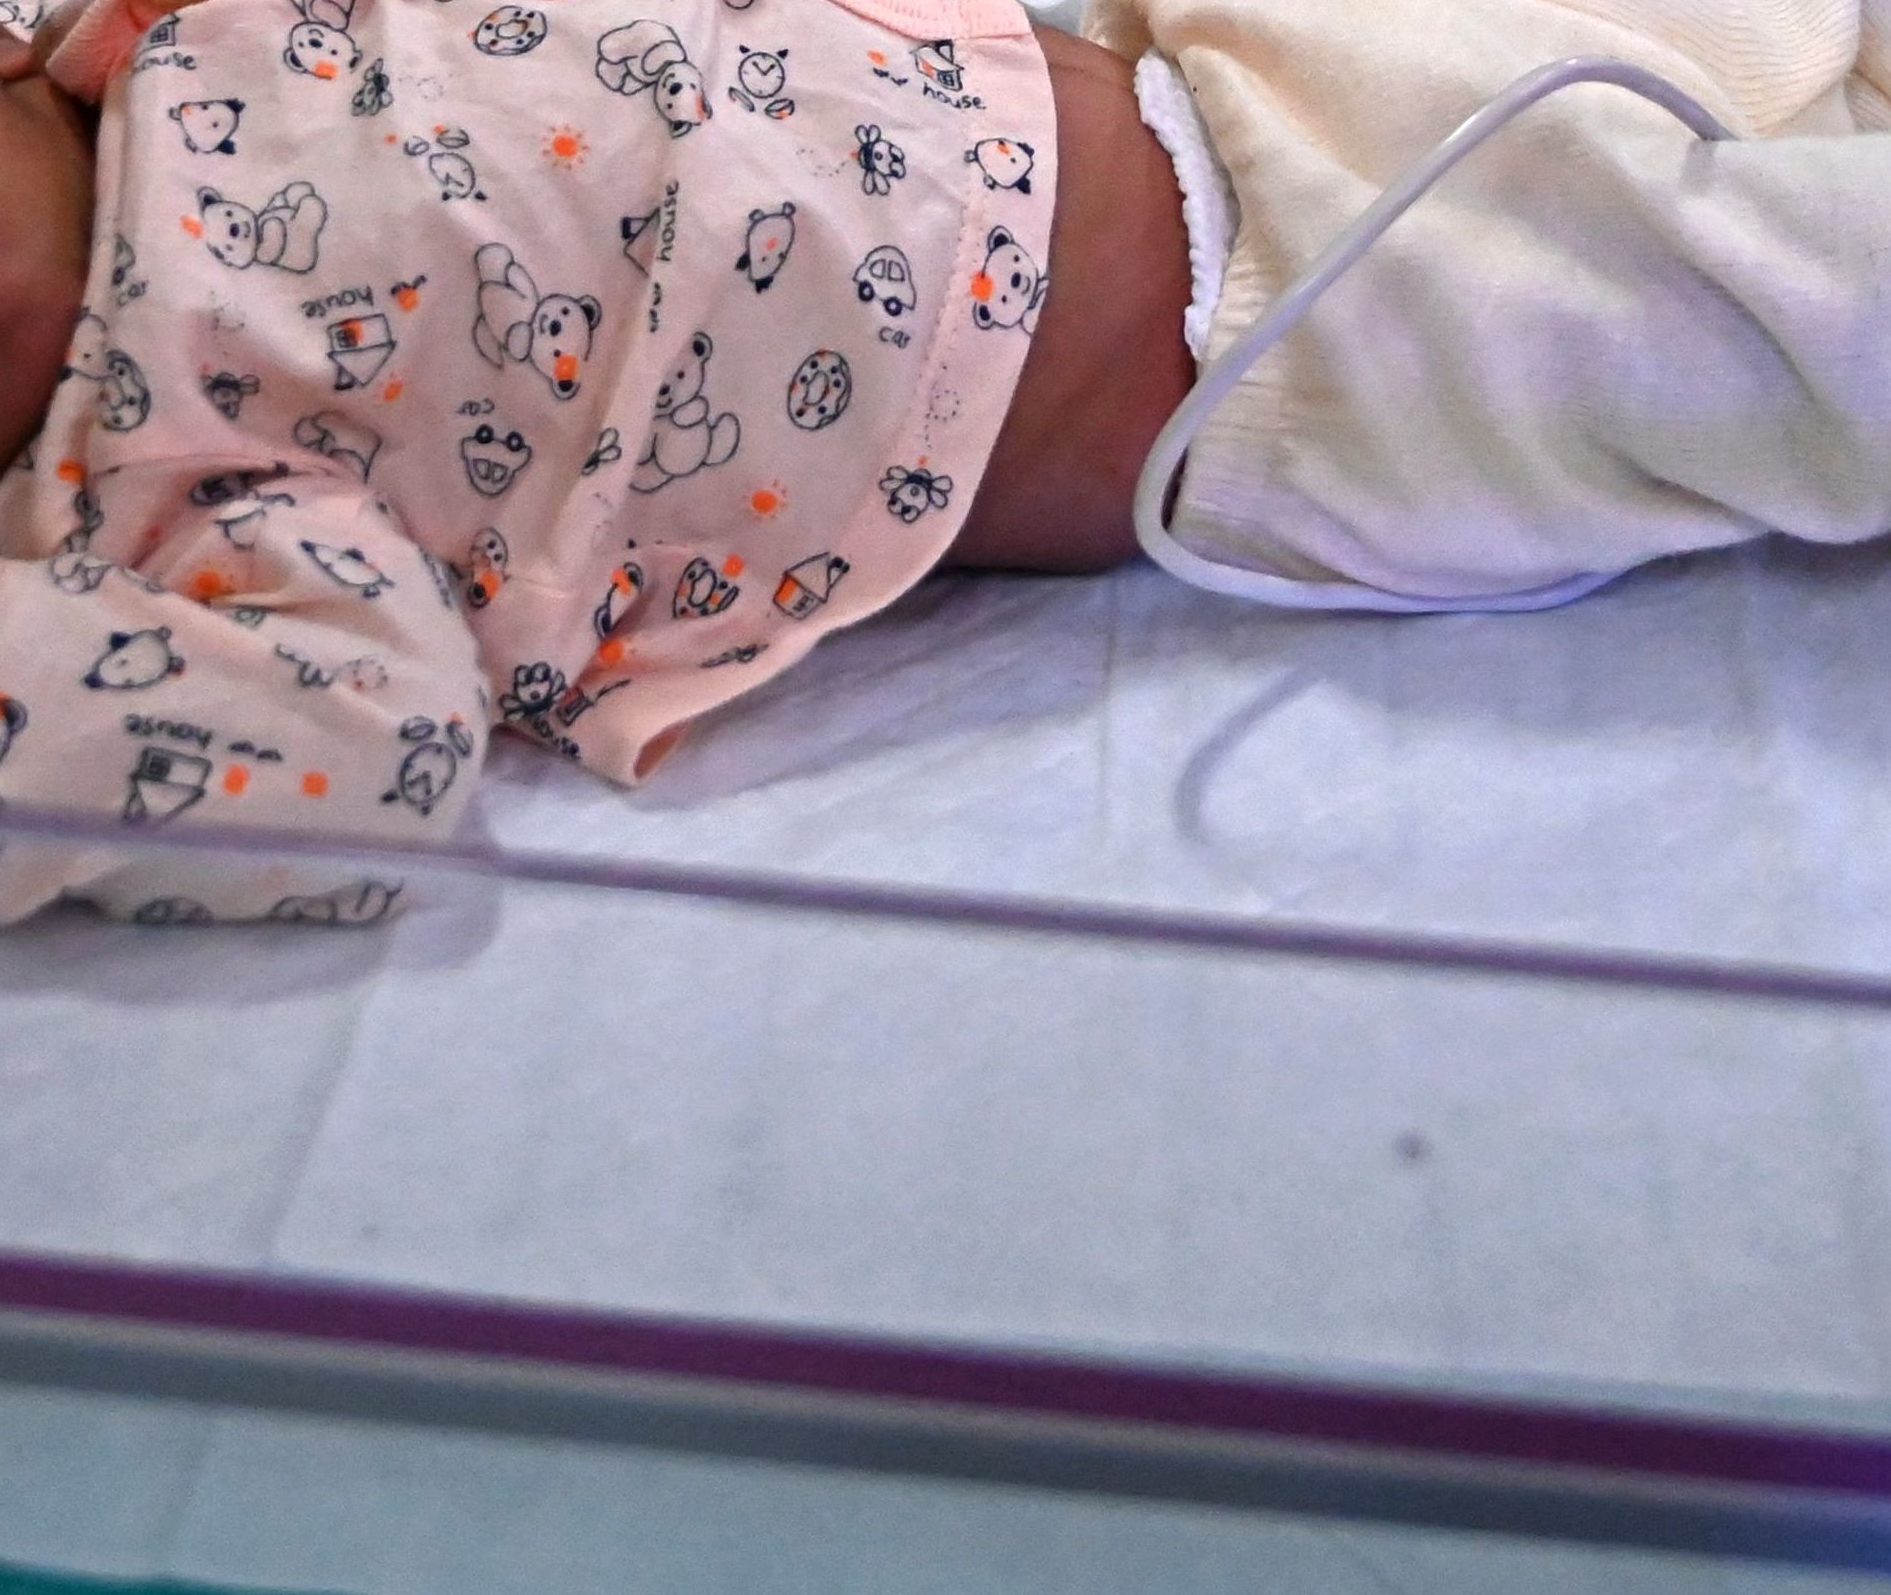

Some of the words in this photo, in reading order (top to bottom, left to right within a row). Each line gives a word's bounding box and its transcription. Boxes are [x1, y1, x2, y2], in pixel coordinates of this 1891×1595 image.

[133, 52, 198, 72] ouse
[922, 81, 988, 110] house
[658, 180, 680, 262] house
[300, 284, 375, 318] house
[878, 325, 912, 350] car
[456, 398, 495, 416] car
[125, 713, 214, 750] house
